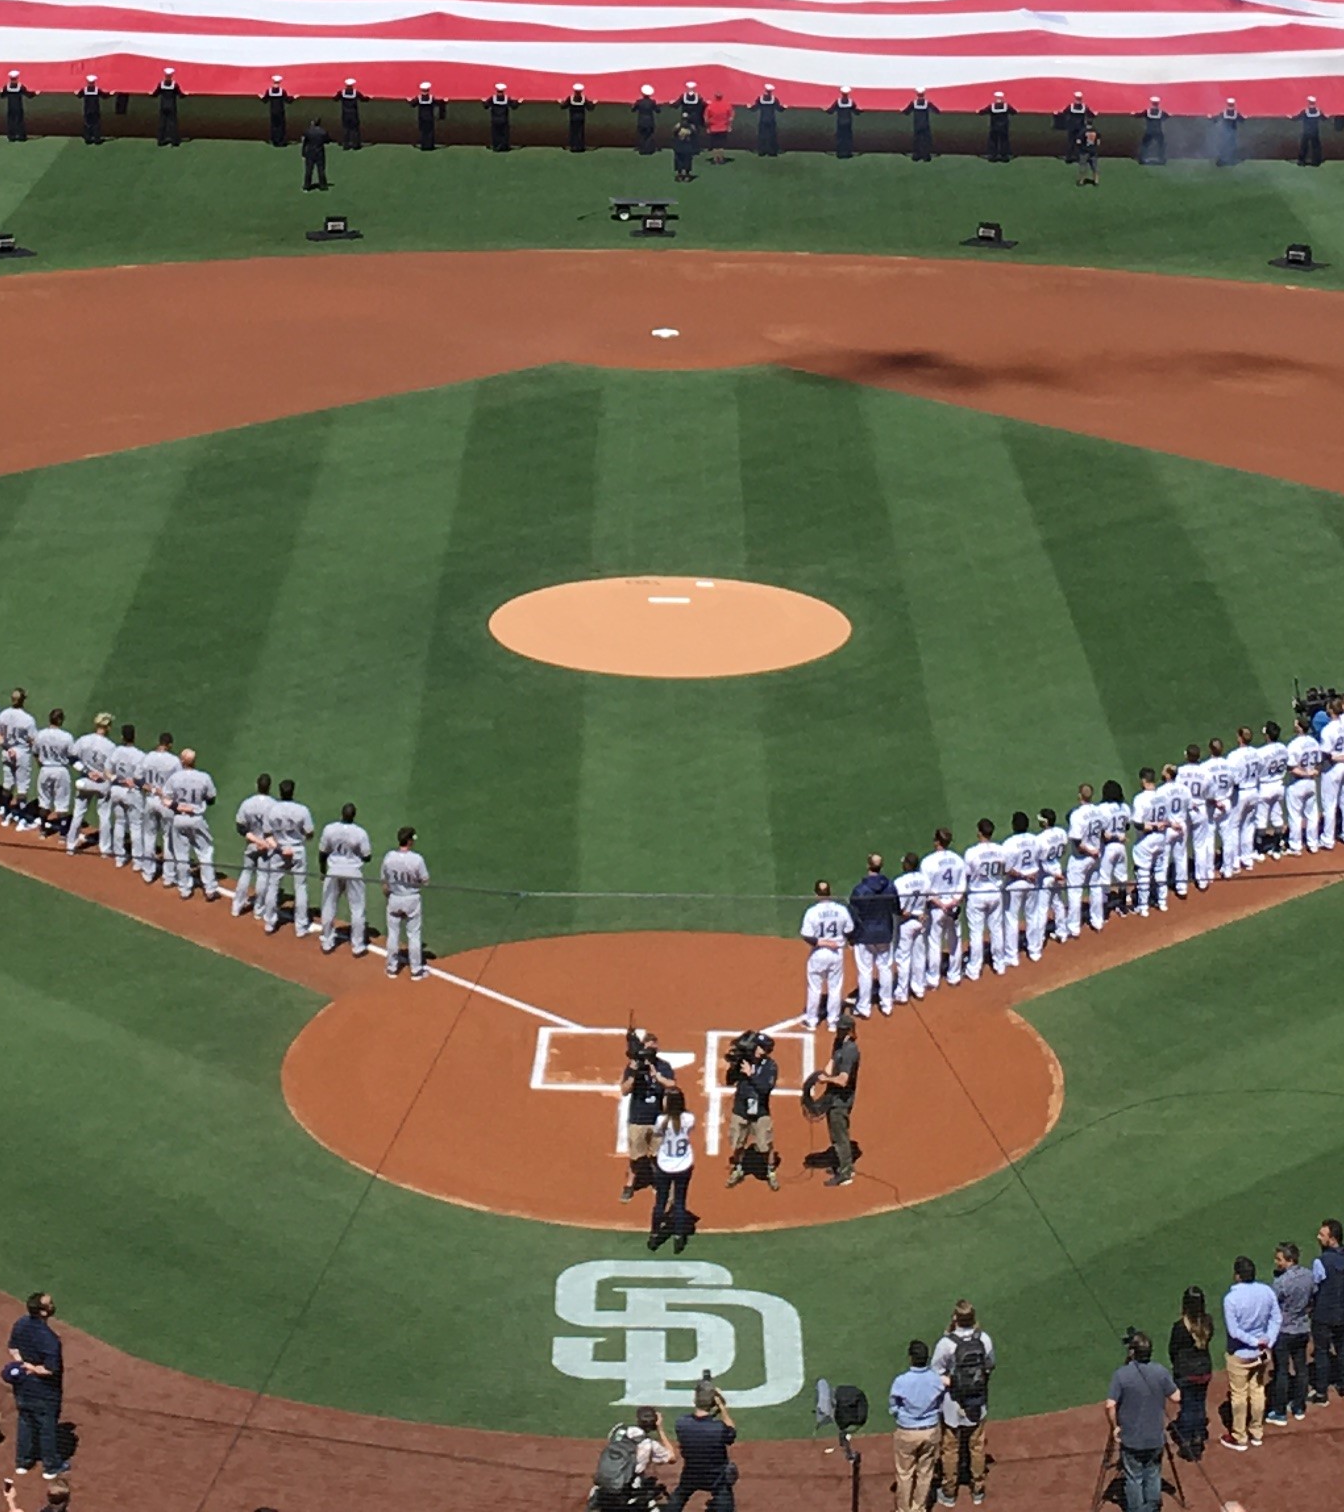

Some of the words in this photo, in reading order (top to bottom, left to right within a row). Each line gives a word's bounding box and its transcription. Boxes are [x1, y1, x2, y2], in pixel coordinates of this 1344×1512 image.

[1300, 750, 1320, 768] 23
[1111, 815, 1127, 833] 13
[1151, 806, 1167, 824] 18
[1087, 819, 1104, 837] 12
[1021, 849, 1032, 867] 2
[941, 867, 954, 886] 4
[981, 861, 1001, 877] 30
[818, 920, 838, 938] 14
[666, 1138, 689, 1159] 18
[551, 1259, 806, 1409] SD
